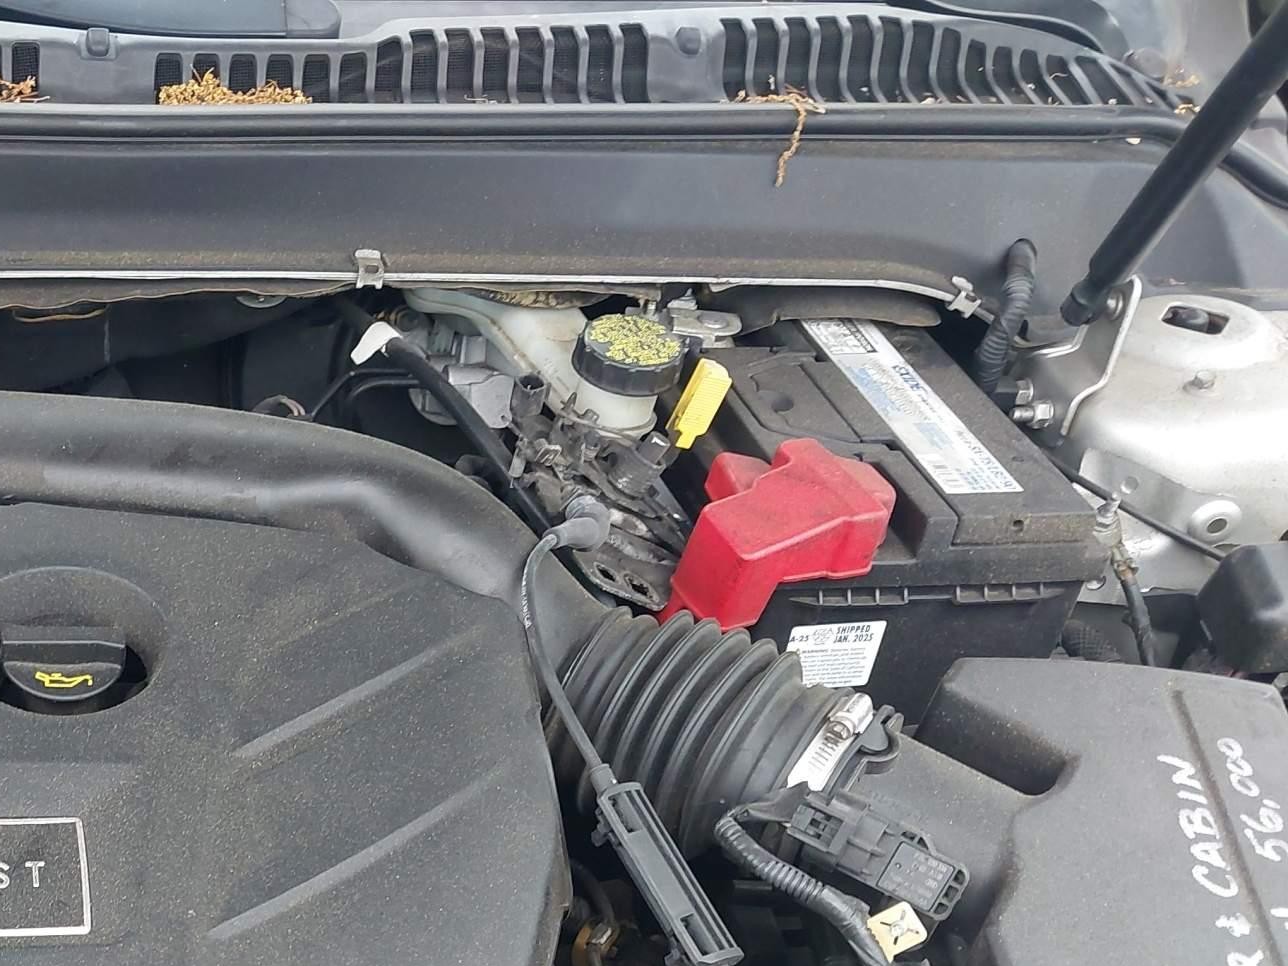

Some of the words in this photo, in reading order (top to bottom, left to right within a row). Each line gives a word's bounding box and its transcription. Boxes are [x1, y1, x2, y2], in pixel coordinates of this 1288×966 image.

[833, 634, 850, 644] JAN.
[852, 633, 874, 643] 2025
[836, 625, 871, 635] SHIPPED
[1157, 754, 1239, 898] CABIN
[1216, 737, 1288, 862] 56,000
